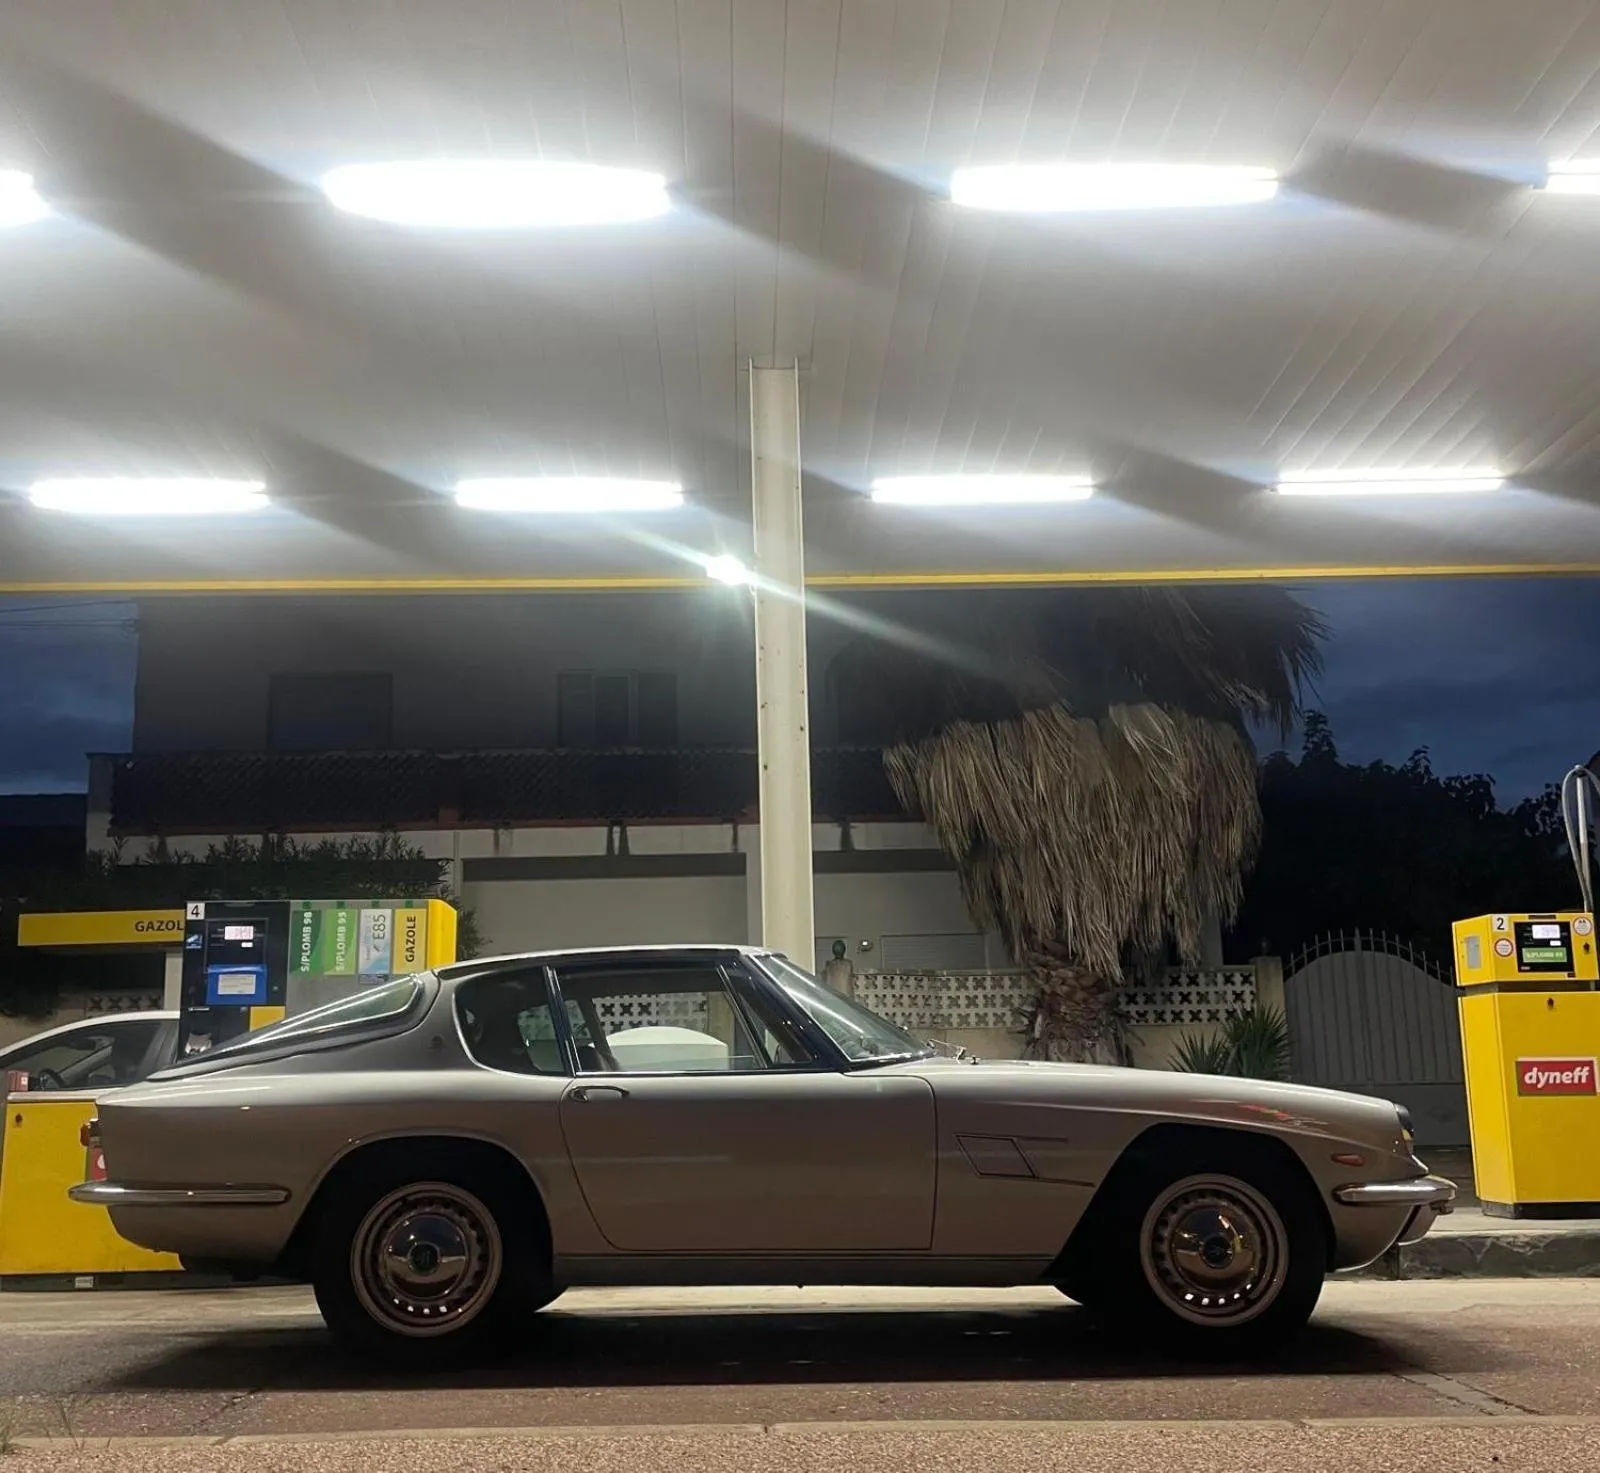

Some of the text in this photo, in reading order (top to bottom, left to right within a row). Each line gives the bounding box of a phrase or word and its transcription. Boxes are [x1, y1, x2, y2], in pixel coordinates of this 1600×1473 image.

[191, 905, 200, 917] 4
[135, 920, 184, 932] GAZOL
[373, 914, 386, 940] E85
[1497, 917, 1505, 930] 2
[301, 911, 312, 972] S/PLOMB 98
[336, 926, 346, 971] S/PLOMB
[406, 916, 416, 962] GAZOLE
[1524, 1066, 1590, 1088] dyneff
